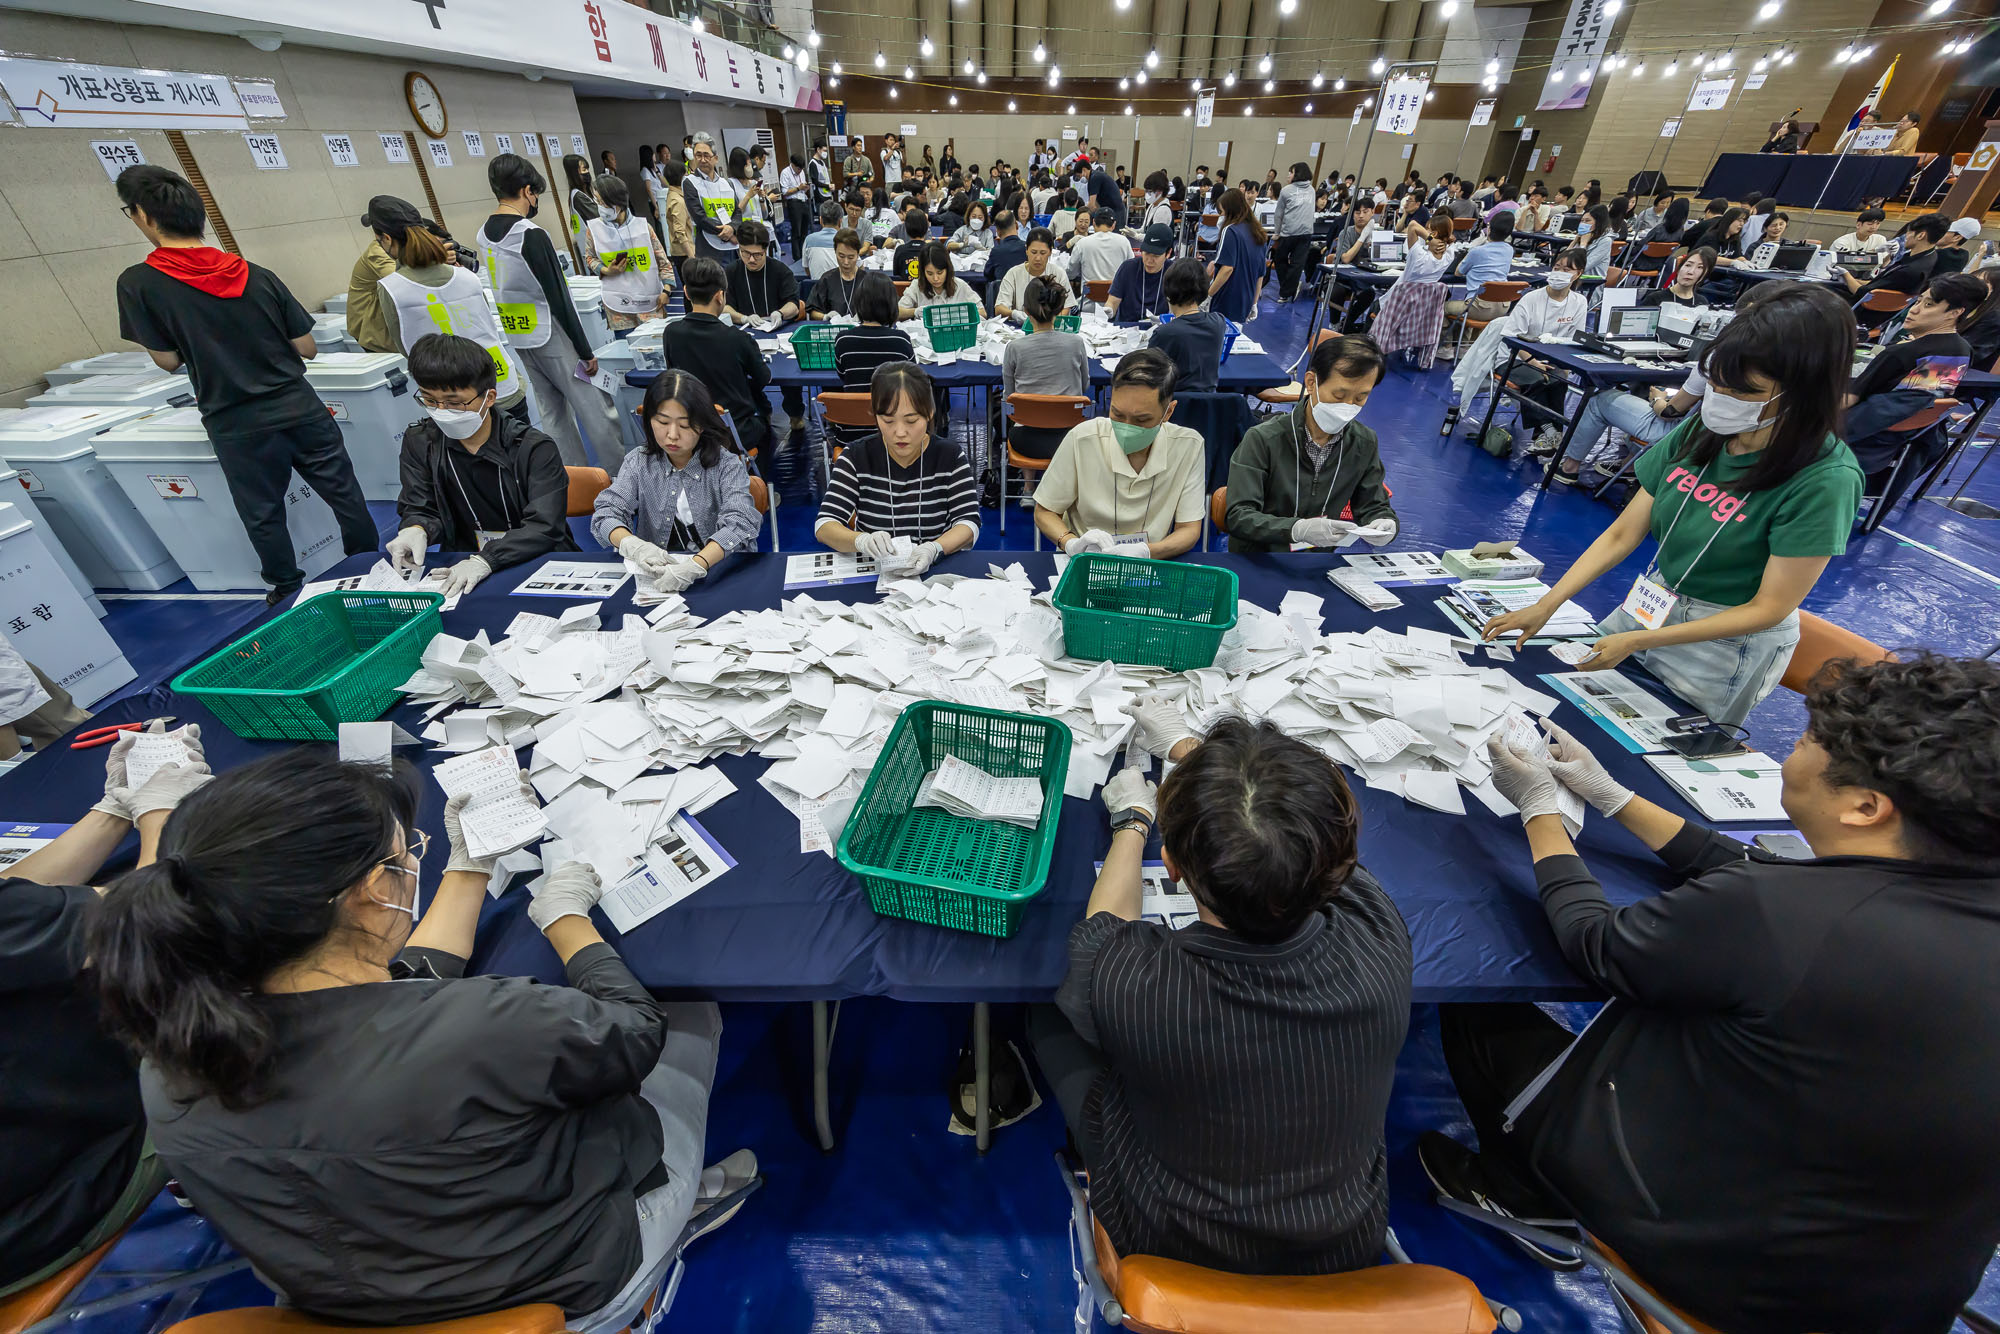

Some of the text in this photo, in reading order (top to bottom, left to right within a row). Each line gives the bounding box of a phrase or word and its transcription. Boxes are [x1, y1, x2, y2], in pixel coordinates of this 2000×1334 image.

[58, 74, 221, 107] 개표상황표 게시대
[249, 138, 278, 154] 다산동
[328, 139, 351, 153] 신당동
[381, 136, 404, 149] 을지로동
[98, 145, 140, 165] 약수동
[263, 156, 279, 166] (4)
[1638, 584, 1668, 610] 개표사무원
